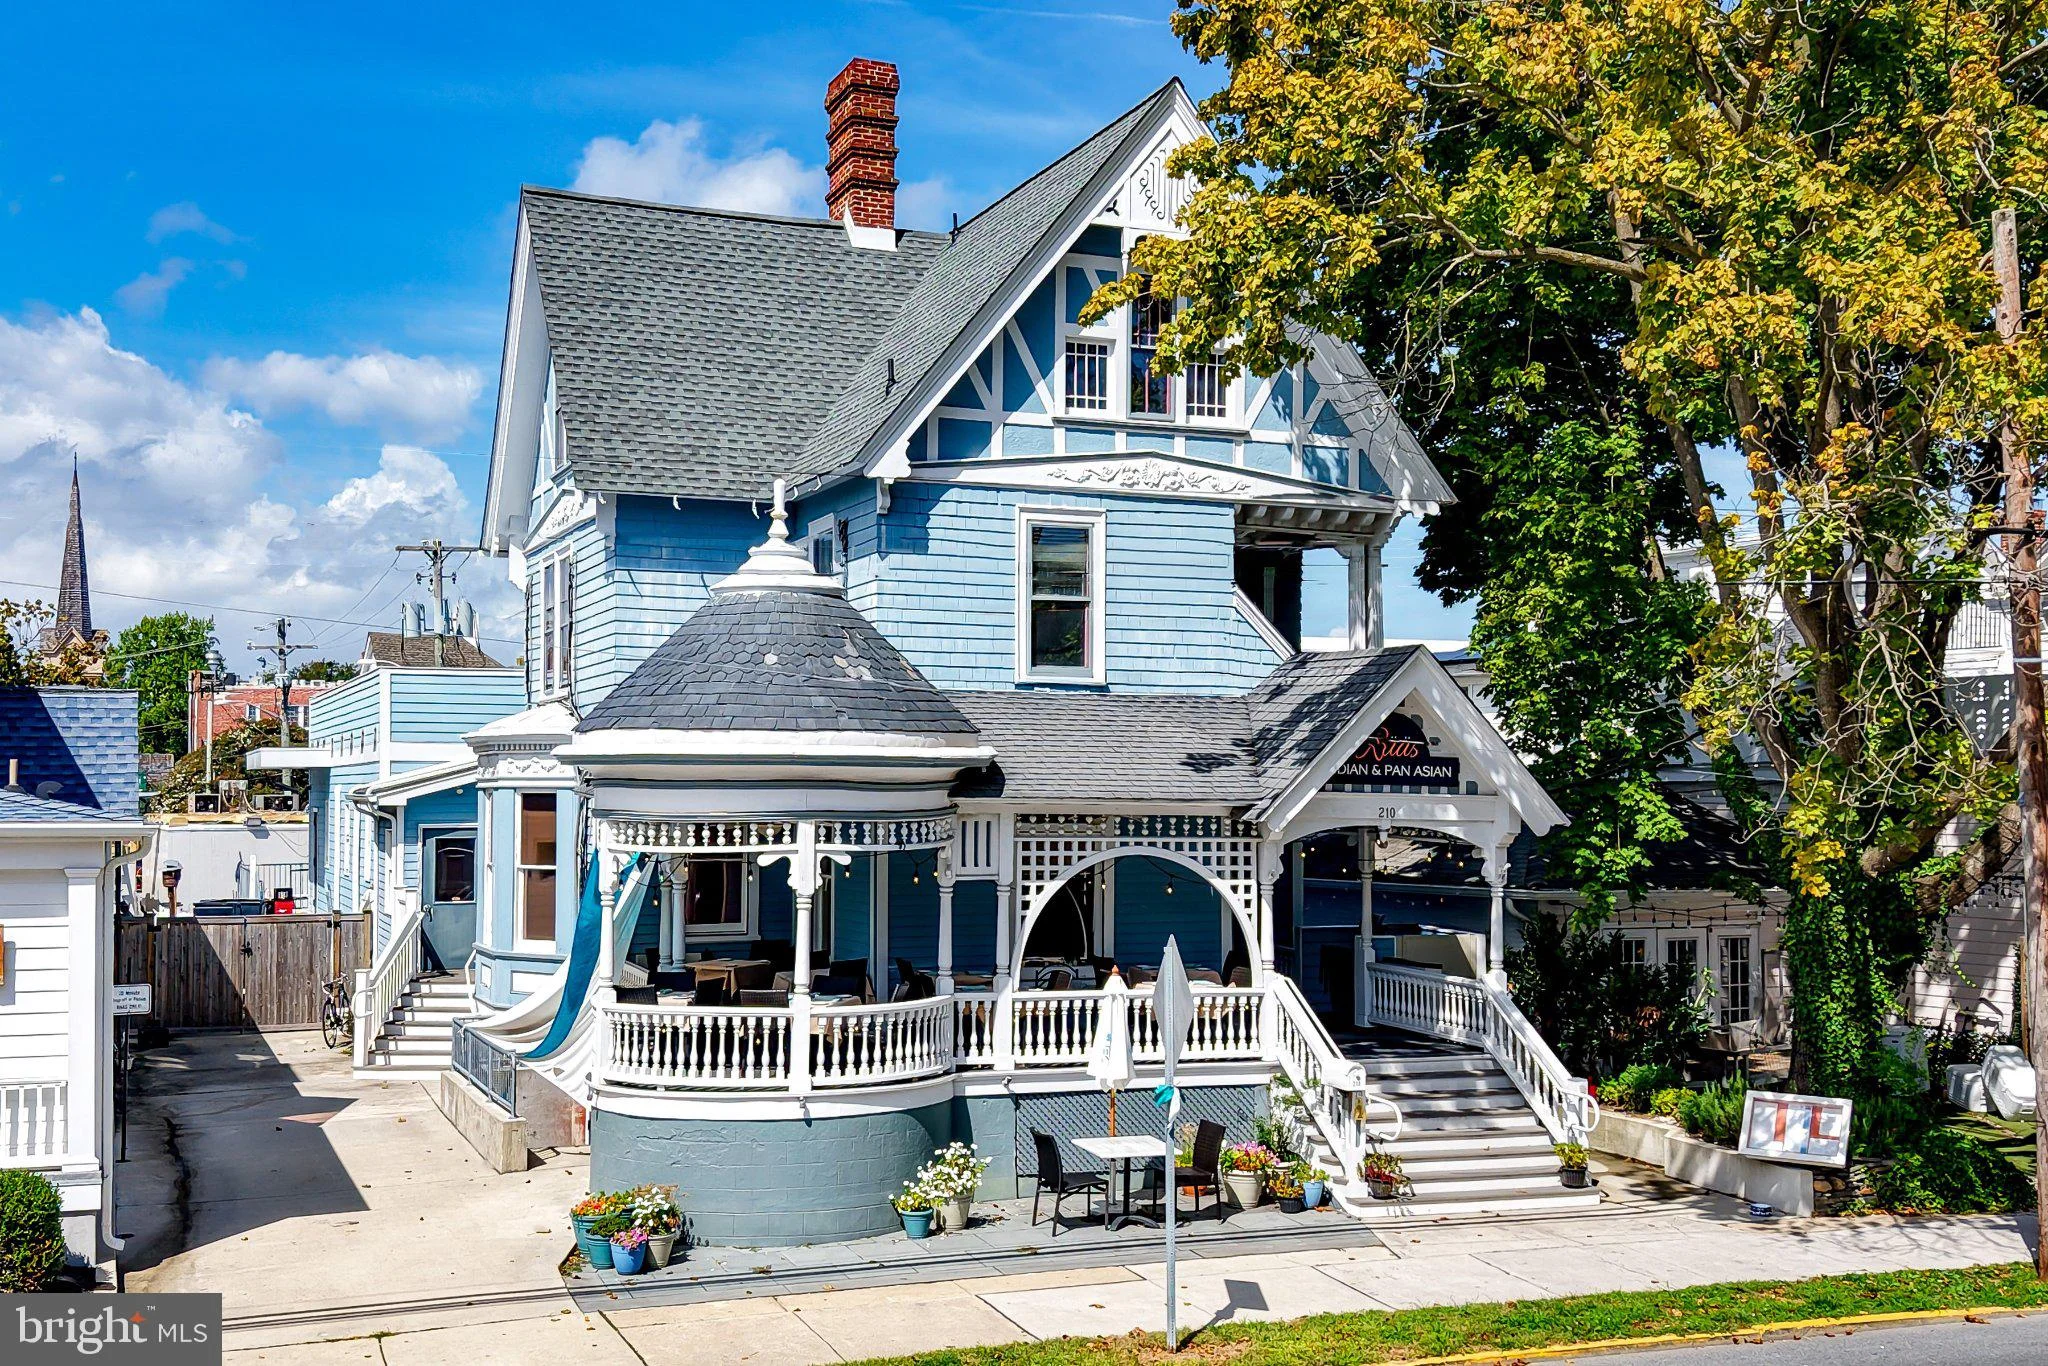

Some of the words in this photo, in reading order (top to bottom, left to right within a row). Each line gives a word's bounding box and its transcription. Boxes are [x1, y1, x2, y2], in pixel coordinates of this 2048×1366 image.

[1371, 764, 1382, 776] &
[1384, 764, 1411, 777] PAN
[1413, 765, 1452, 778] ASIAN
[1378, 807, 1396, 819] 210
